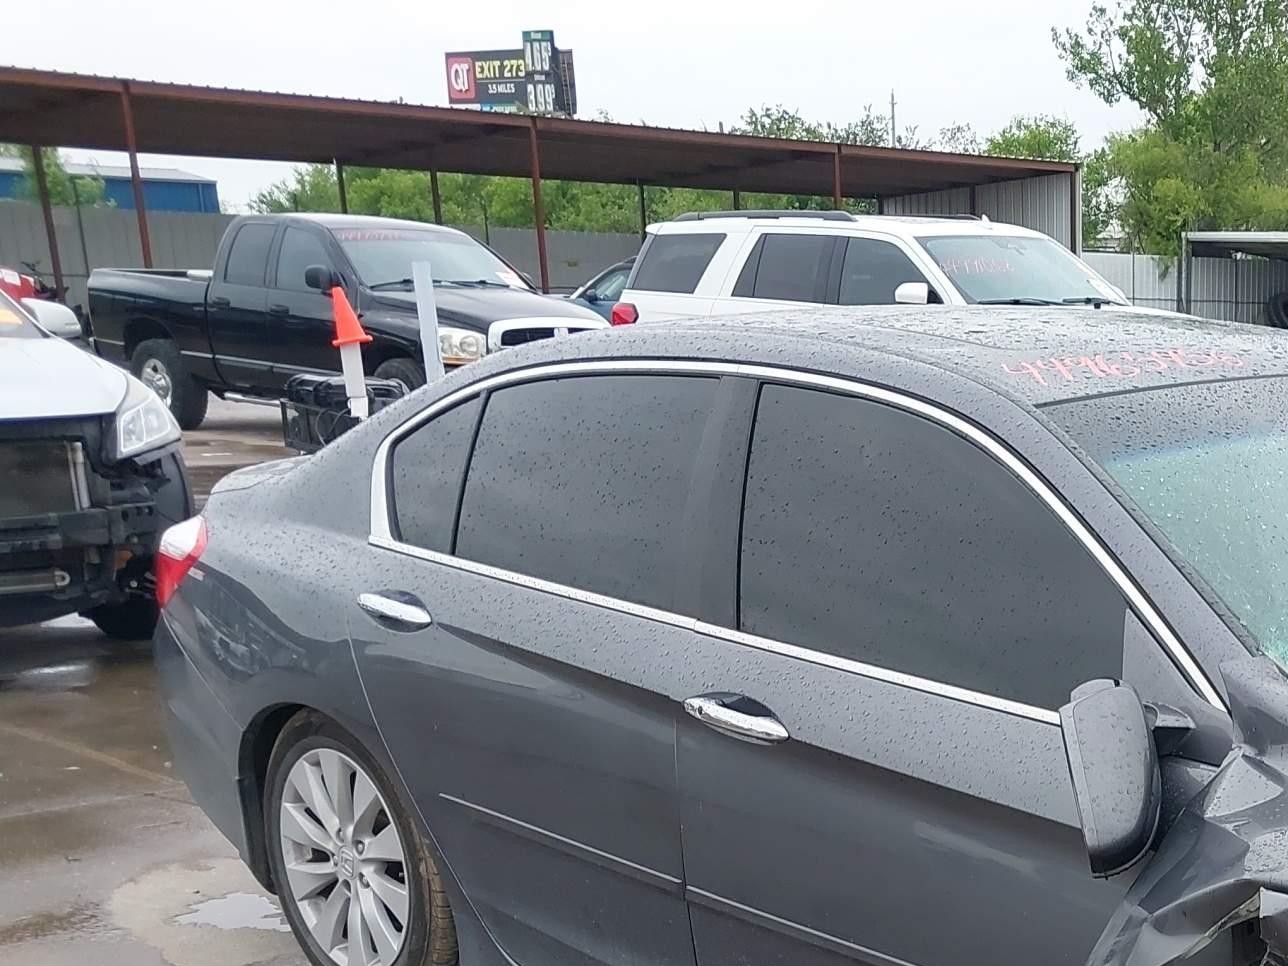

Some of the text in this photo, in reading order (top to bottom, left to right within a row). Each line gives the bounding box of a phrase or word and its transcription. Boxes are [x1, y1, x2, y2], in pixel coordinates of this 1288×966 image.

[450, 63, 470, 93] QT
[475, 58, 526, 79] EXIT 273
[497, 83, 515, 94] MILES
